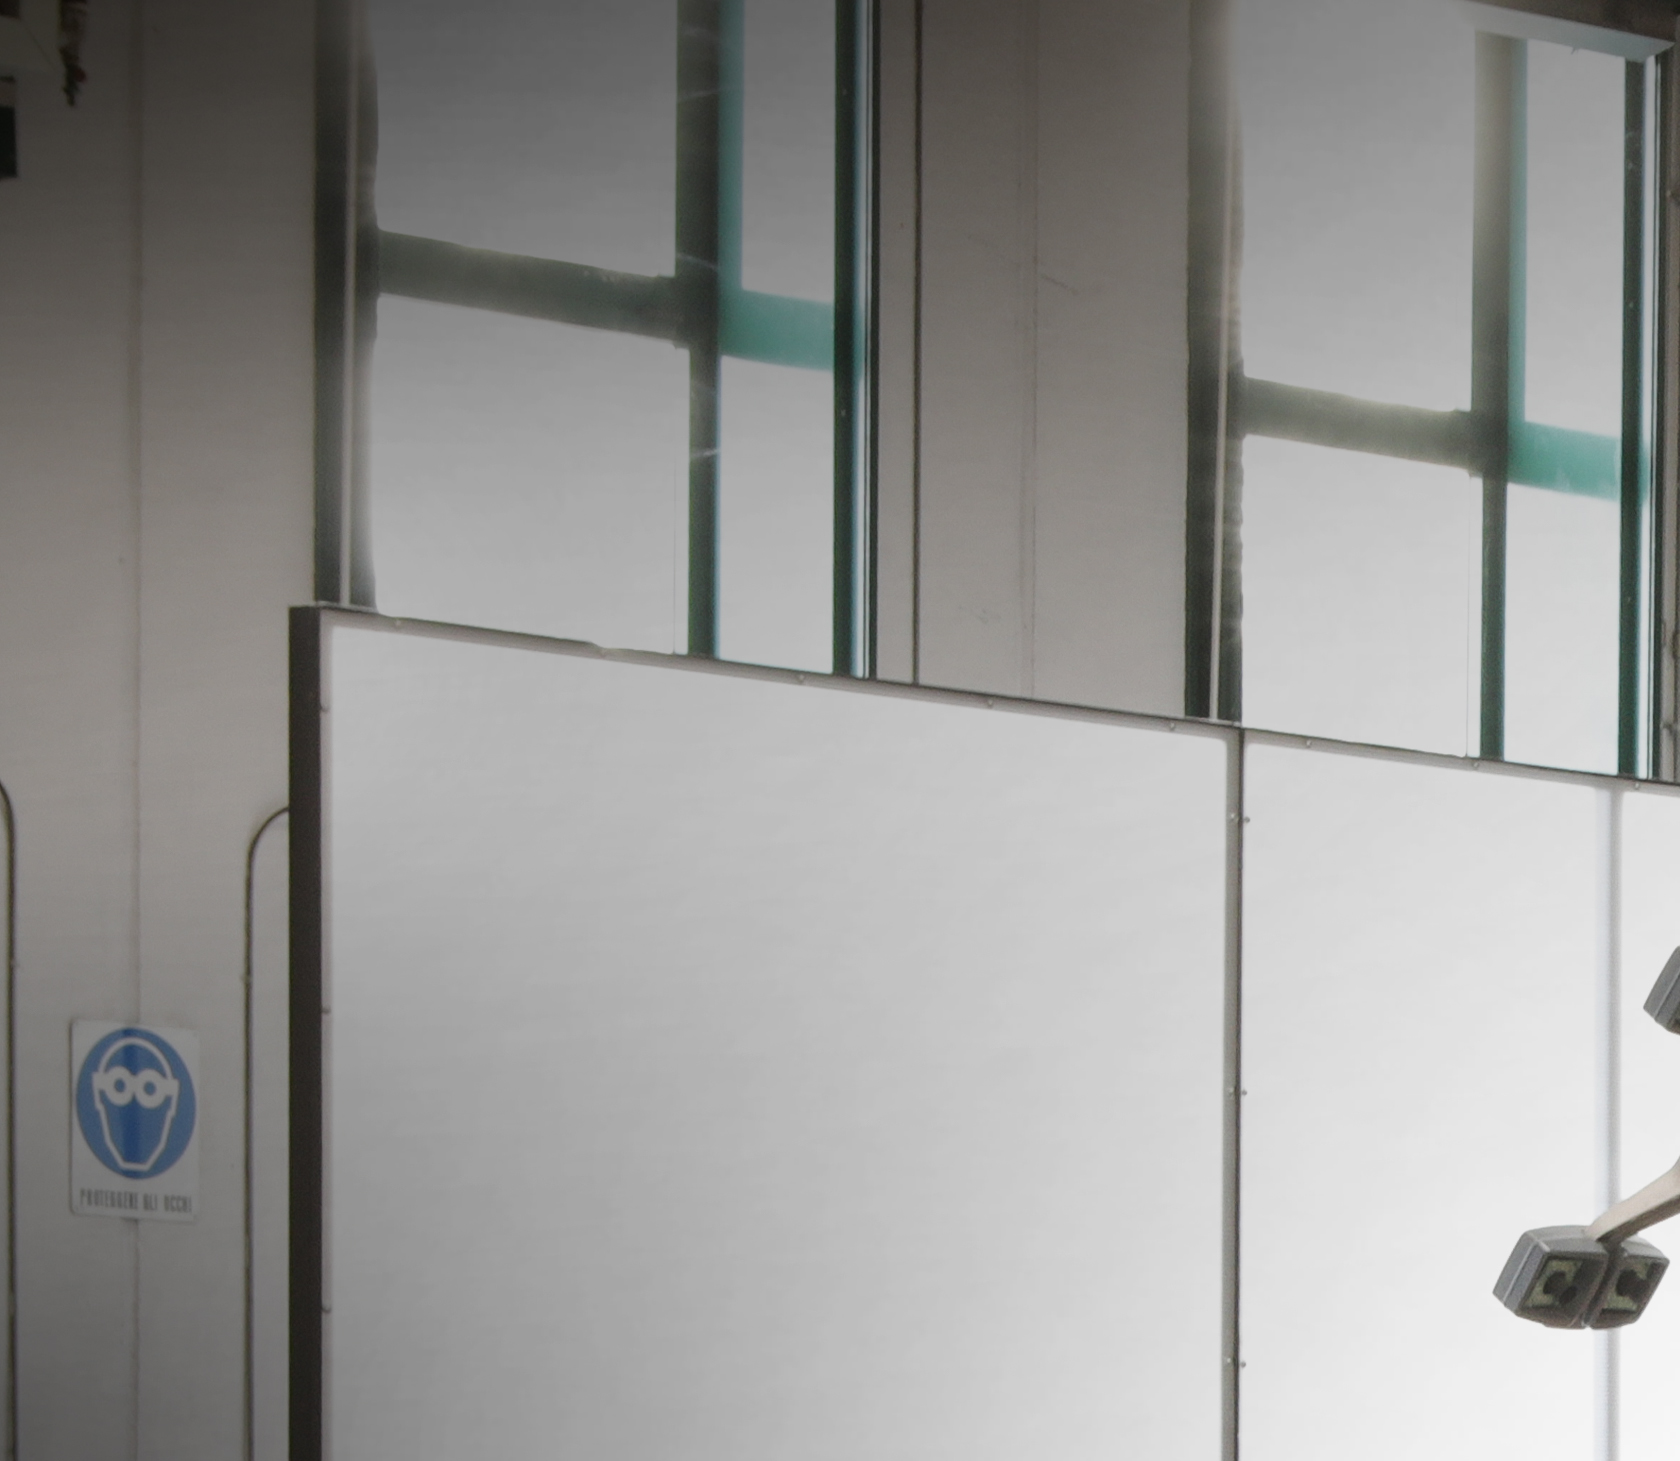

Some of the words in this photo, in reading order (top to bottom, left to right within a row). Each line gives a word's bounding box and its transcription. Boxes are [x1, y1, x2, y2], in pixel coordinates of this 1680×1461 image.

[79, 1187, 139, 1210] PROTEGGERE
[142, 1193, 159, 1211] GLI
[163, 1194, 193, 1213] OCCHI
